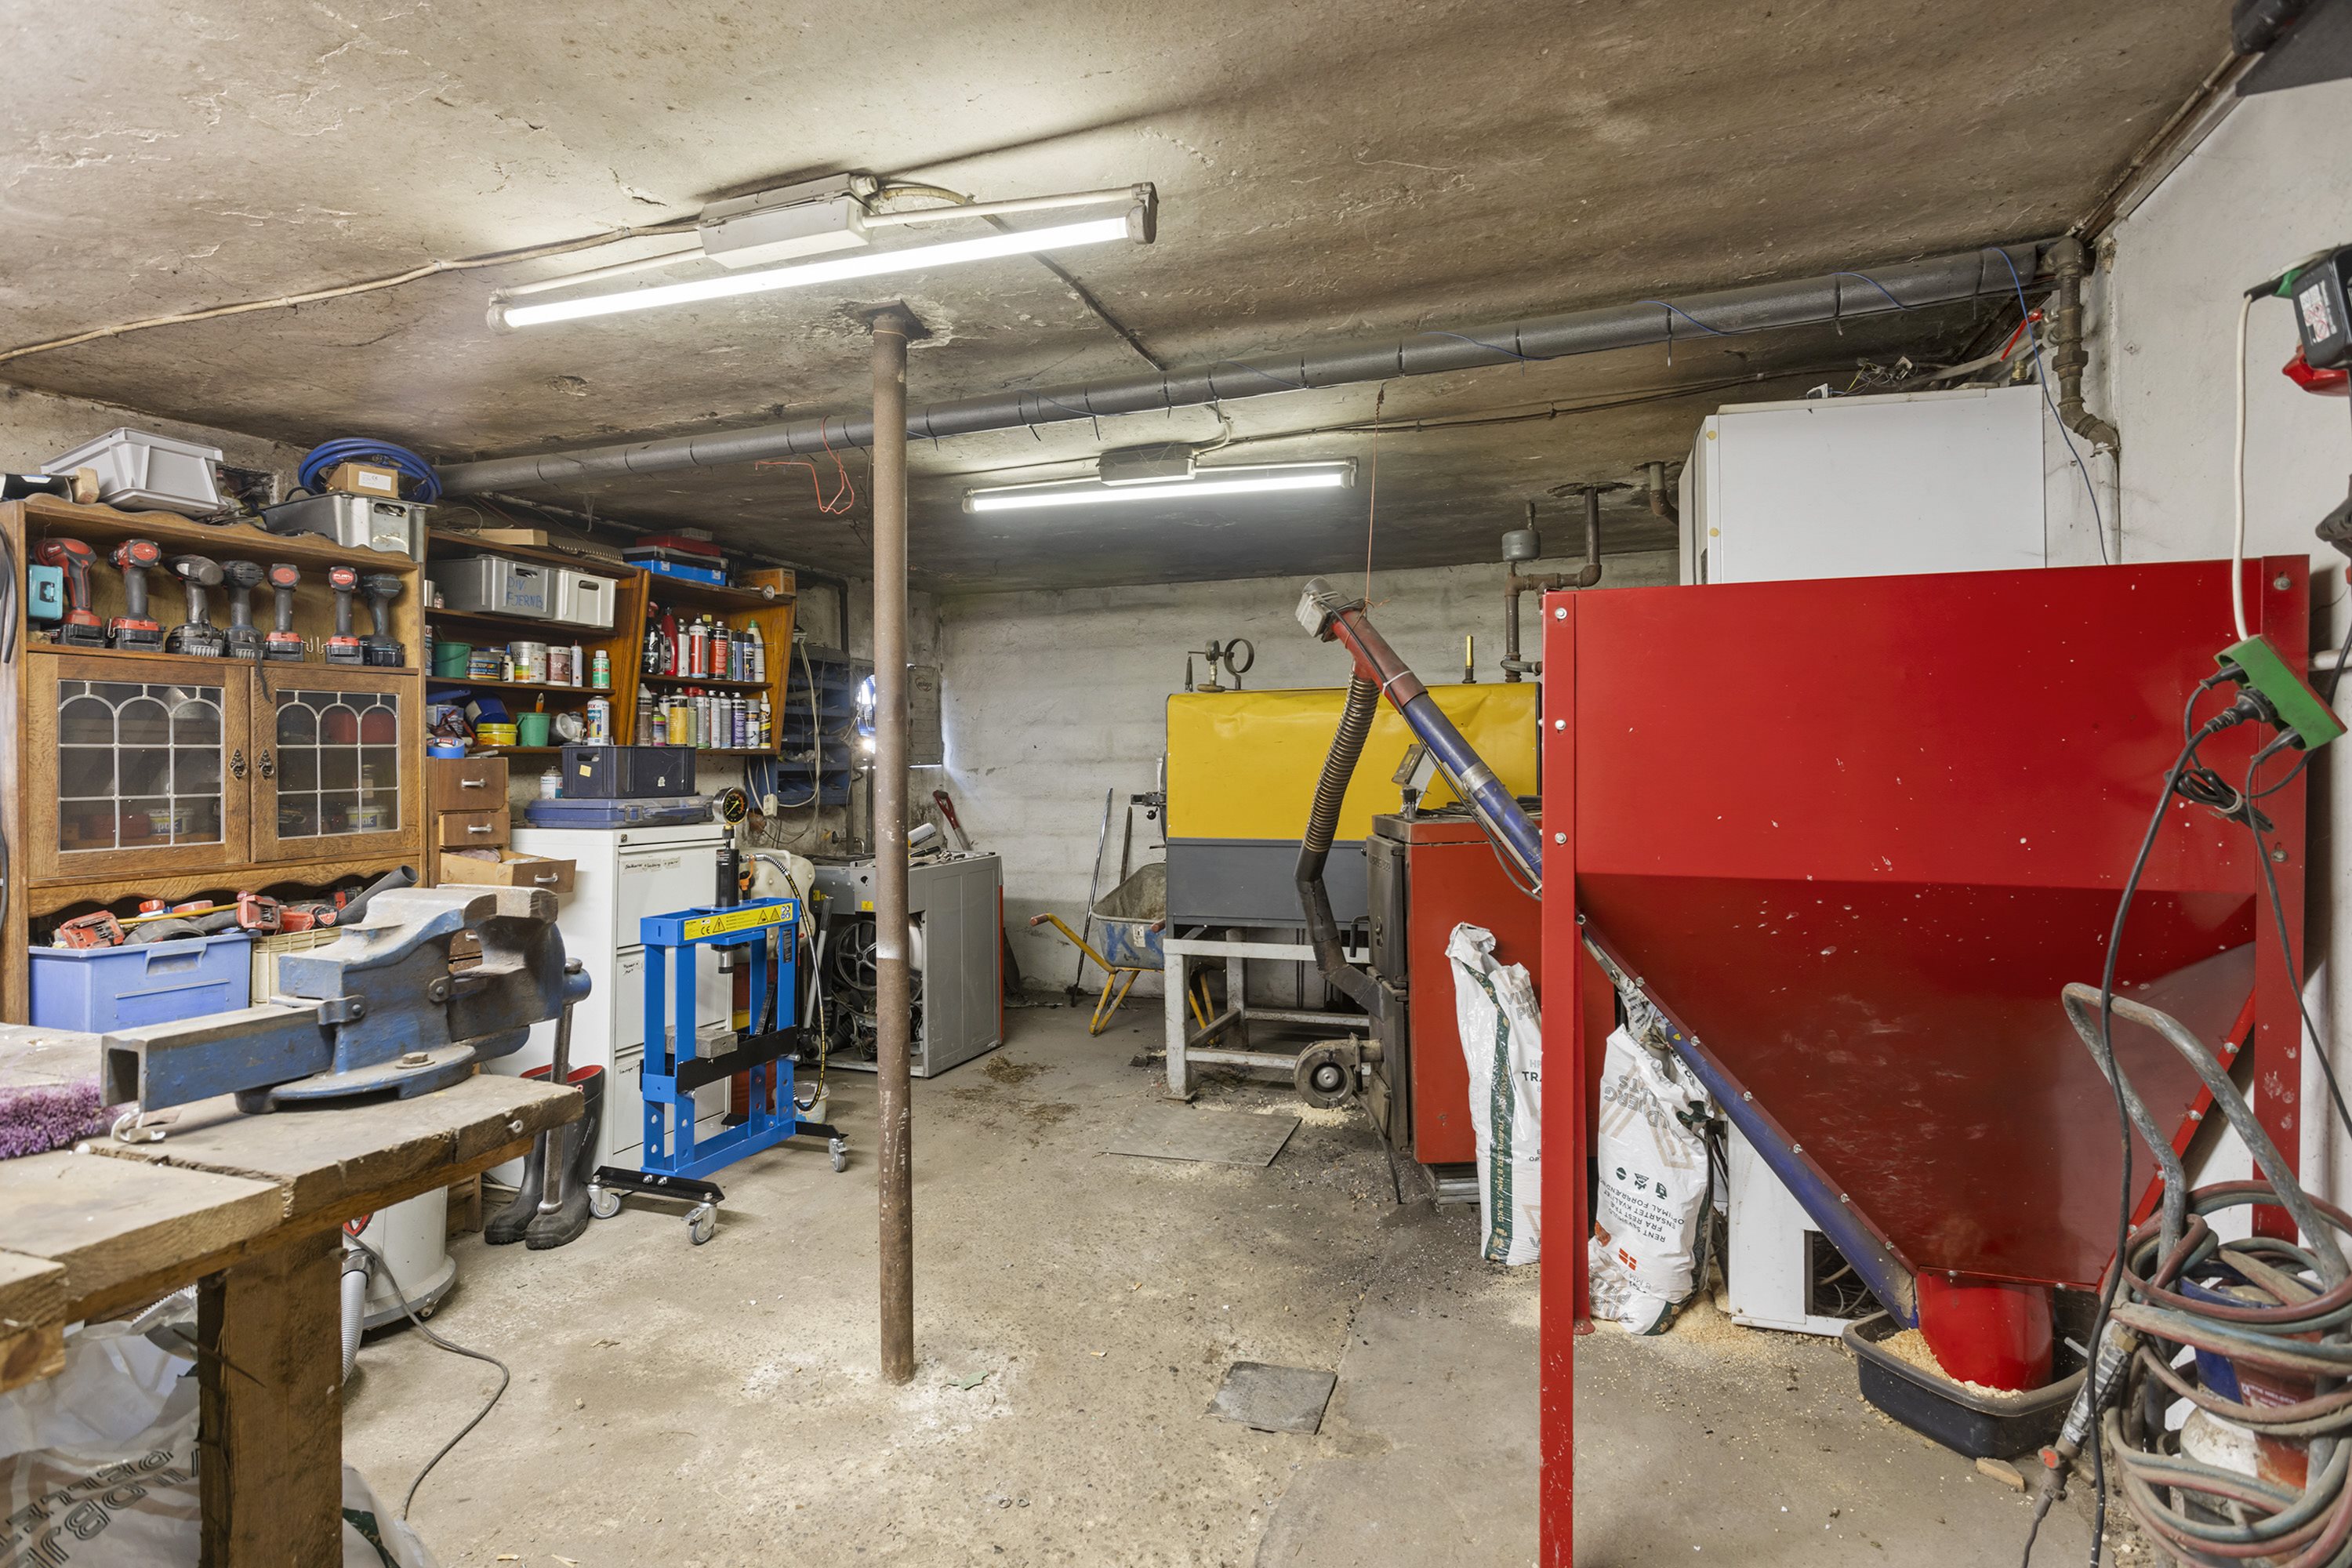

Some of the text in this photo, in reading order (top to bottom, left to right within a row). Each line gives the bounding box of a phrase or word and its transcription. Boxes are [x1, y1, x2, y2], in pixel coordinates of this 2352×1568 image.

[1522, 1071, 1542, 1082] TR
[1624, 1212, 1642, 1225] REST
[1645, 1221, 1663, 1232] FRA
[1642, 1229, 1666, 1243] RENT
